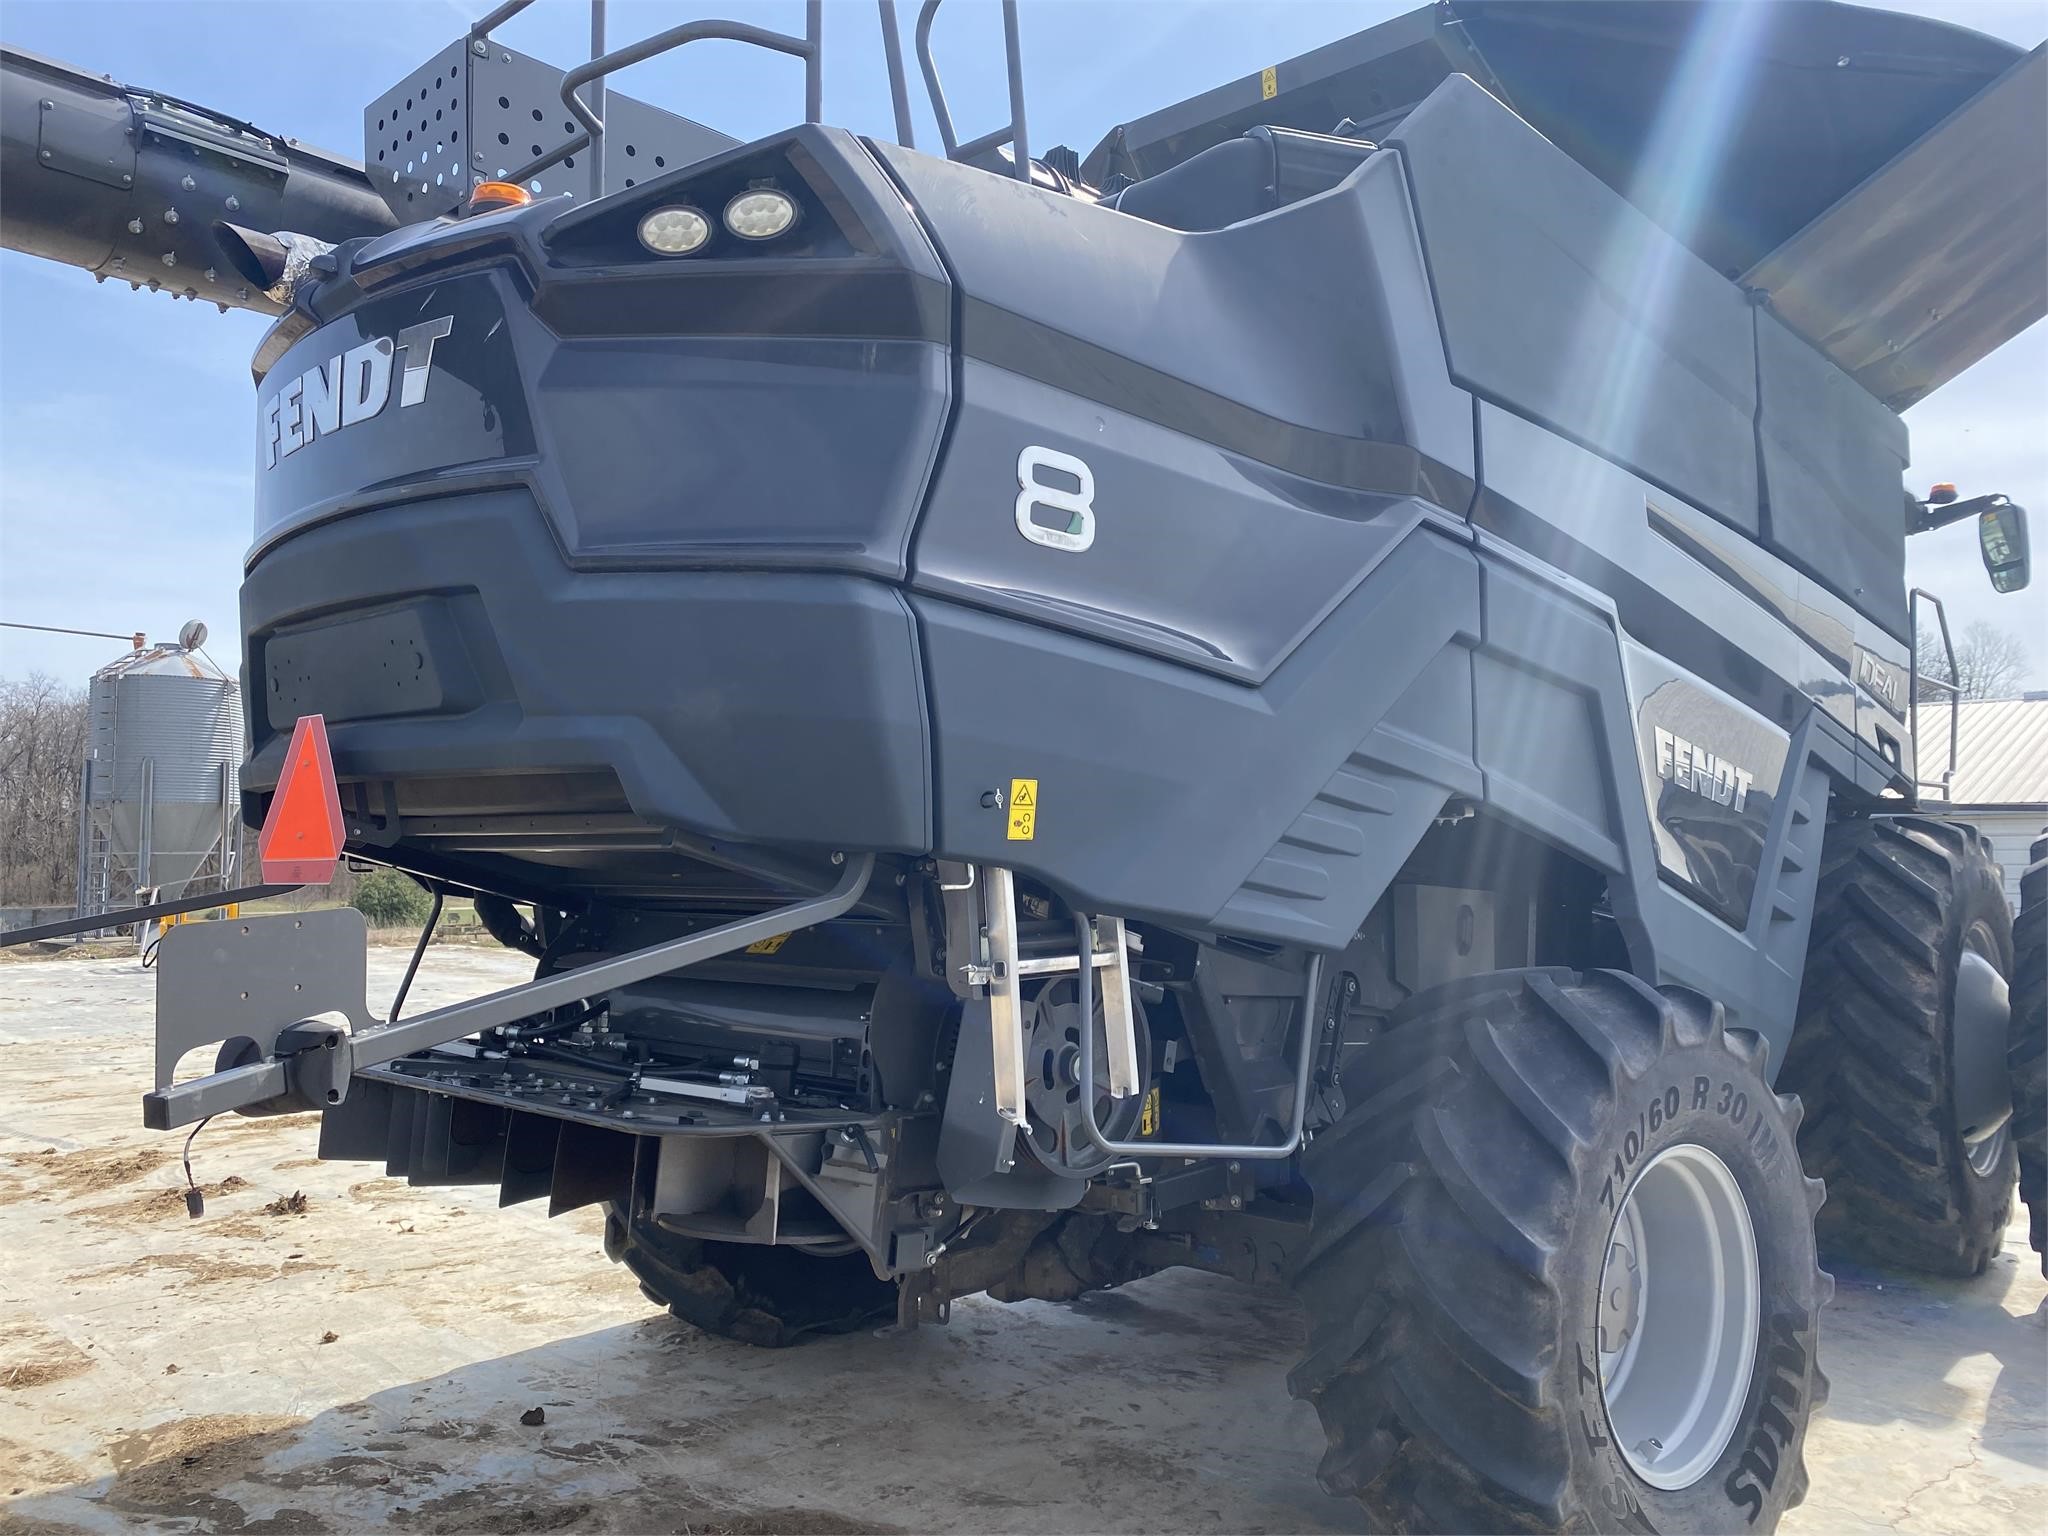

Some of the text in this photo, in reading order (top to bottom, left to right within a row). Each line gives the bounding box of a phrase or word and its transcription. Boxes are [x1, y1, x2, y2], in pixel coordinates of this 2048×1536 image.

[263, 314, 455, 471] FENDT
[1015, 445, 1096, 553] 8
[1654, 725, 1754, 814] FENDT
[1600, 1085, 1680, 1217] 710/60
[1691, 1076, 1710, 1110] R
[1717, 1082, 1748, 1124] 30
